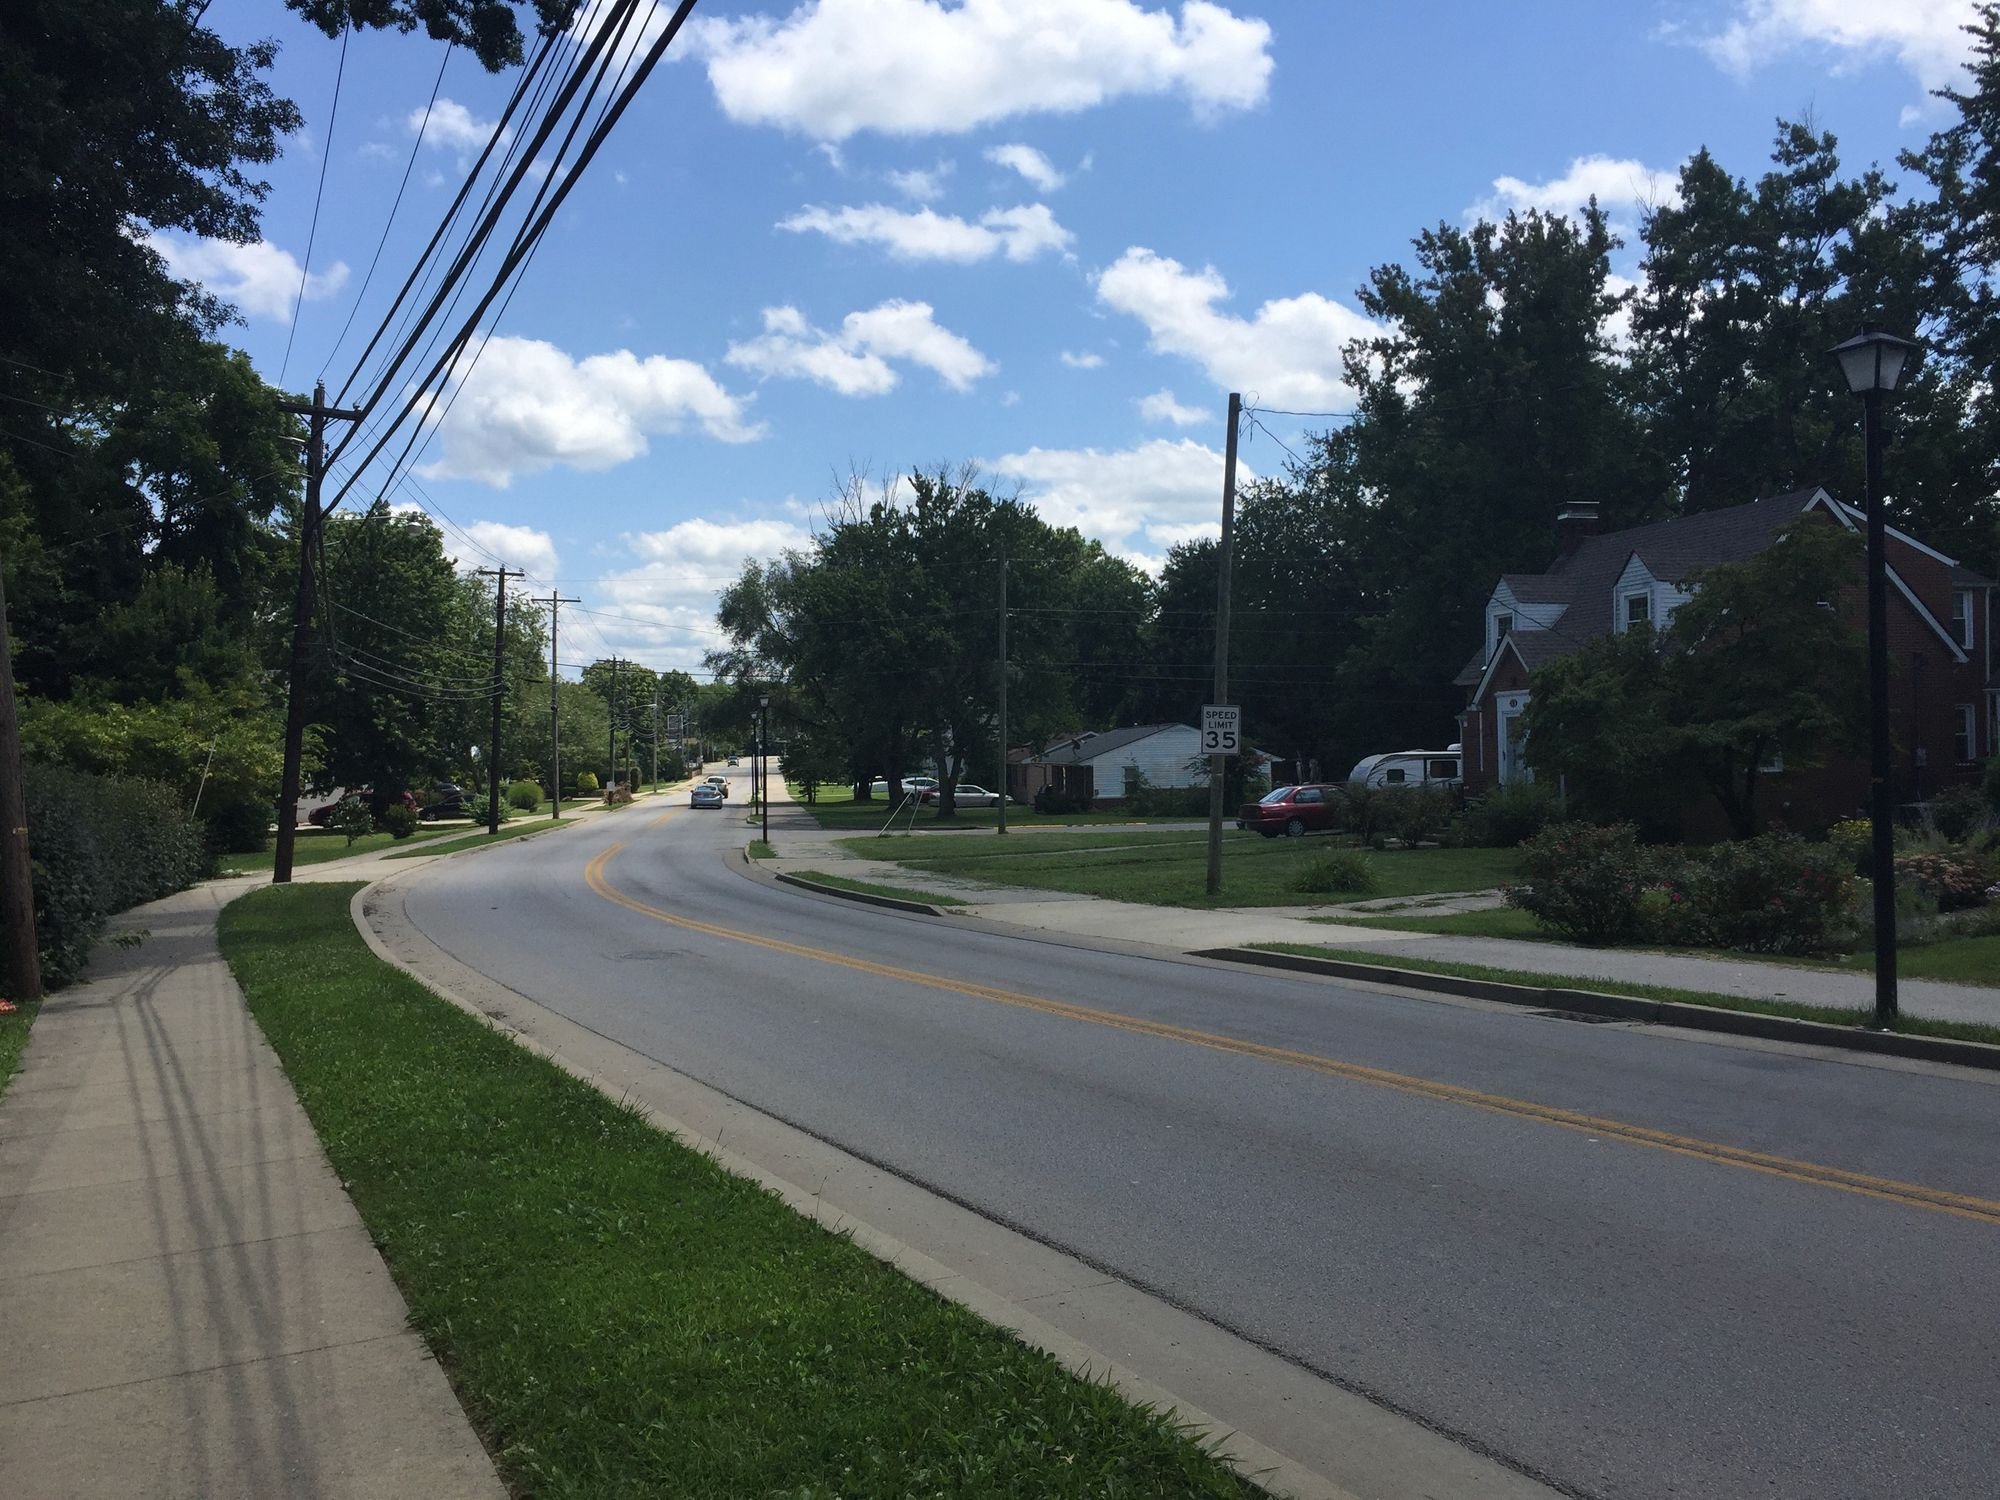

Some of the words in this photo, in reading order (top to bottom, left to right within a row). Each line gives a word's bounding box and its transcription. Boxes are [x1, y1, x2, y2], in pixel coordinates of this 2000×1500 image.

[1205, 711, 1237, 719] SPEED
[1208, 721, 1233, 729] LIMIT
[1205, 731, 1236, 749] 35
